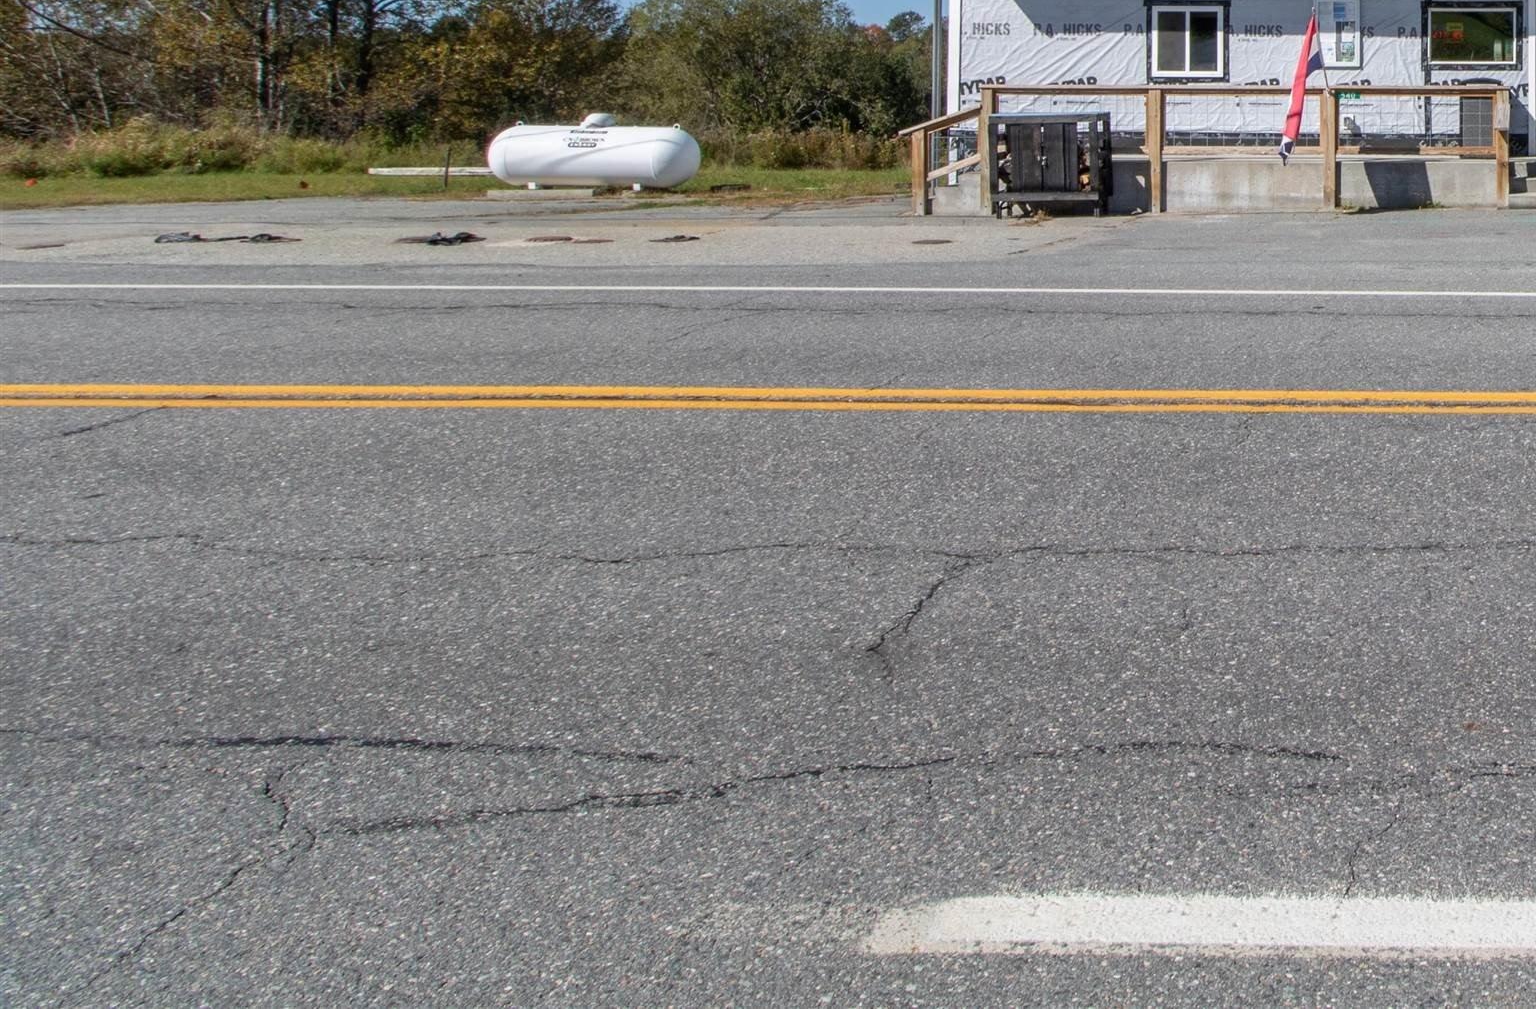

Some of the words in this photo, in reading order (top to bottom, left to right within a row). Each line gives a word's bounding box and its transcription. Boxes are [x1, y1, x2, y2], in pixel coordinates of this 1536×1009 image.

[972, 22, 1011, 36] HICKS
[1063, 23, 1102, 37] HICKS
[1124, 23, 1144, 37] P.A
[1244, 24, 1283, 38] HICKS
[1397, 26, 1417, 38] P.A
